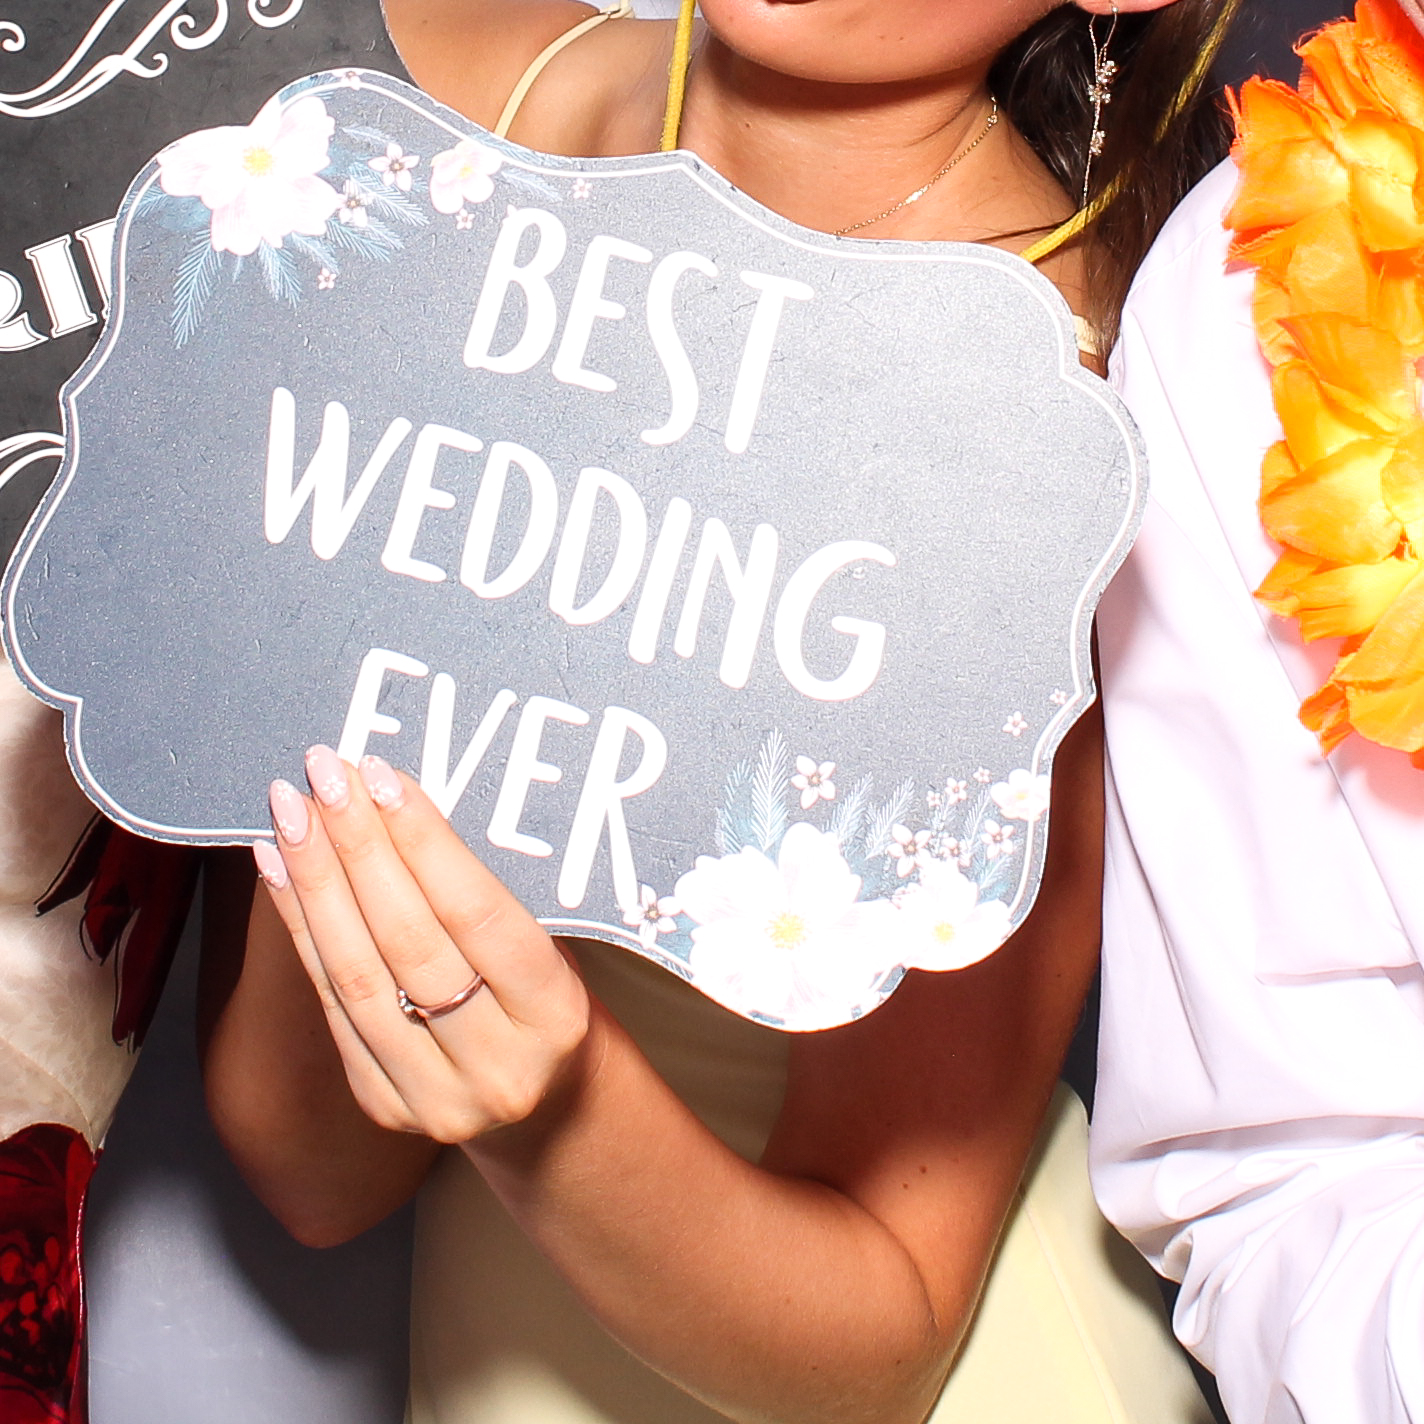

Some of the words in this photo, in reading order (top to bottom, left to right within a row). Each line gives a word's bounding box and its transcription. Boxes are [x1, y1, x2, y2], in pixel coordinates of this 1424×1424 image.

[463, 206, 816, 455] BEST
[263, 386, 898, 702] WEDDING
[336, 647, 669, 912] EVER
